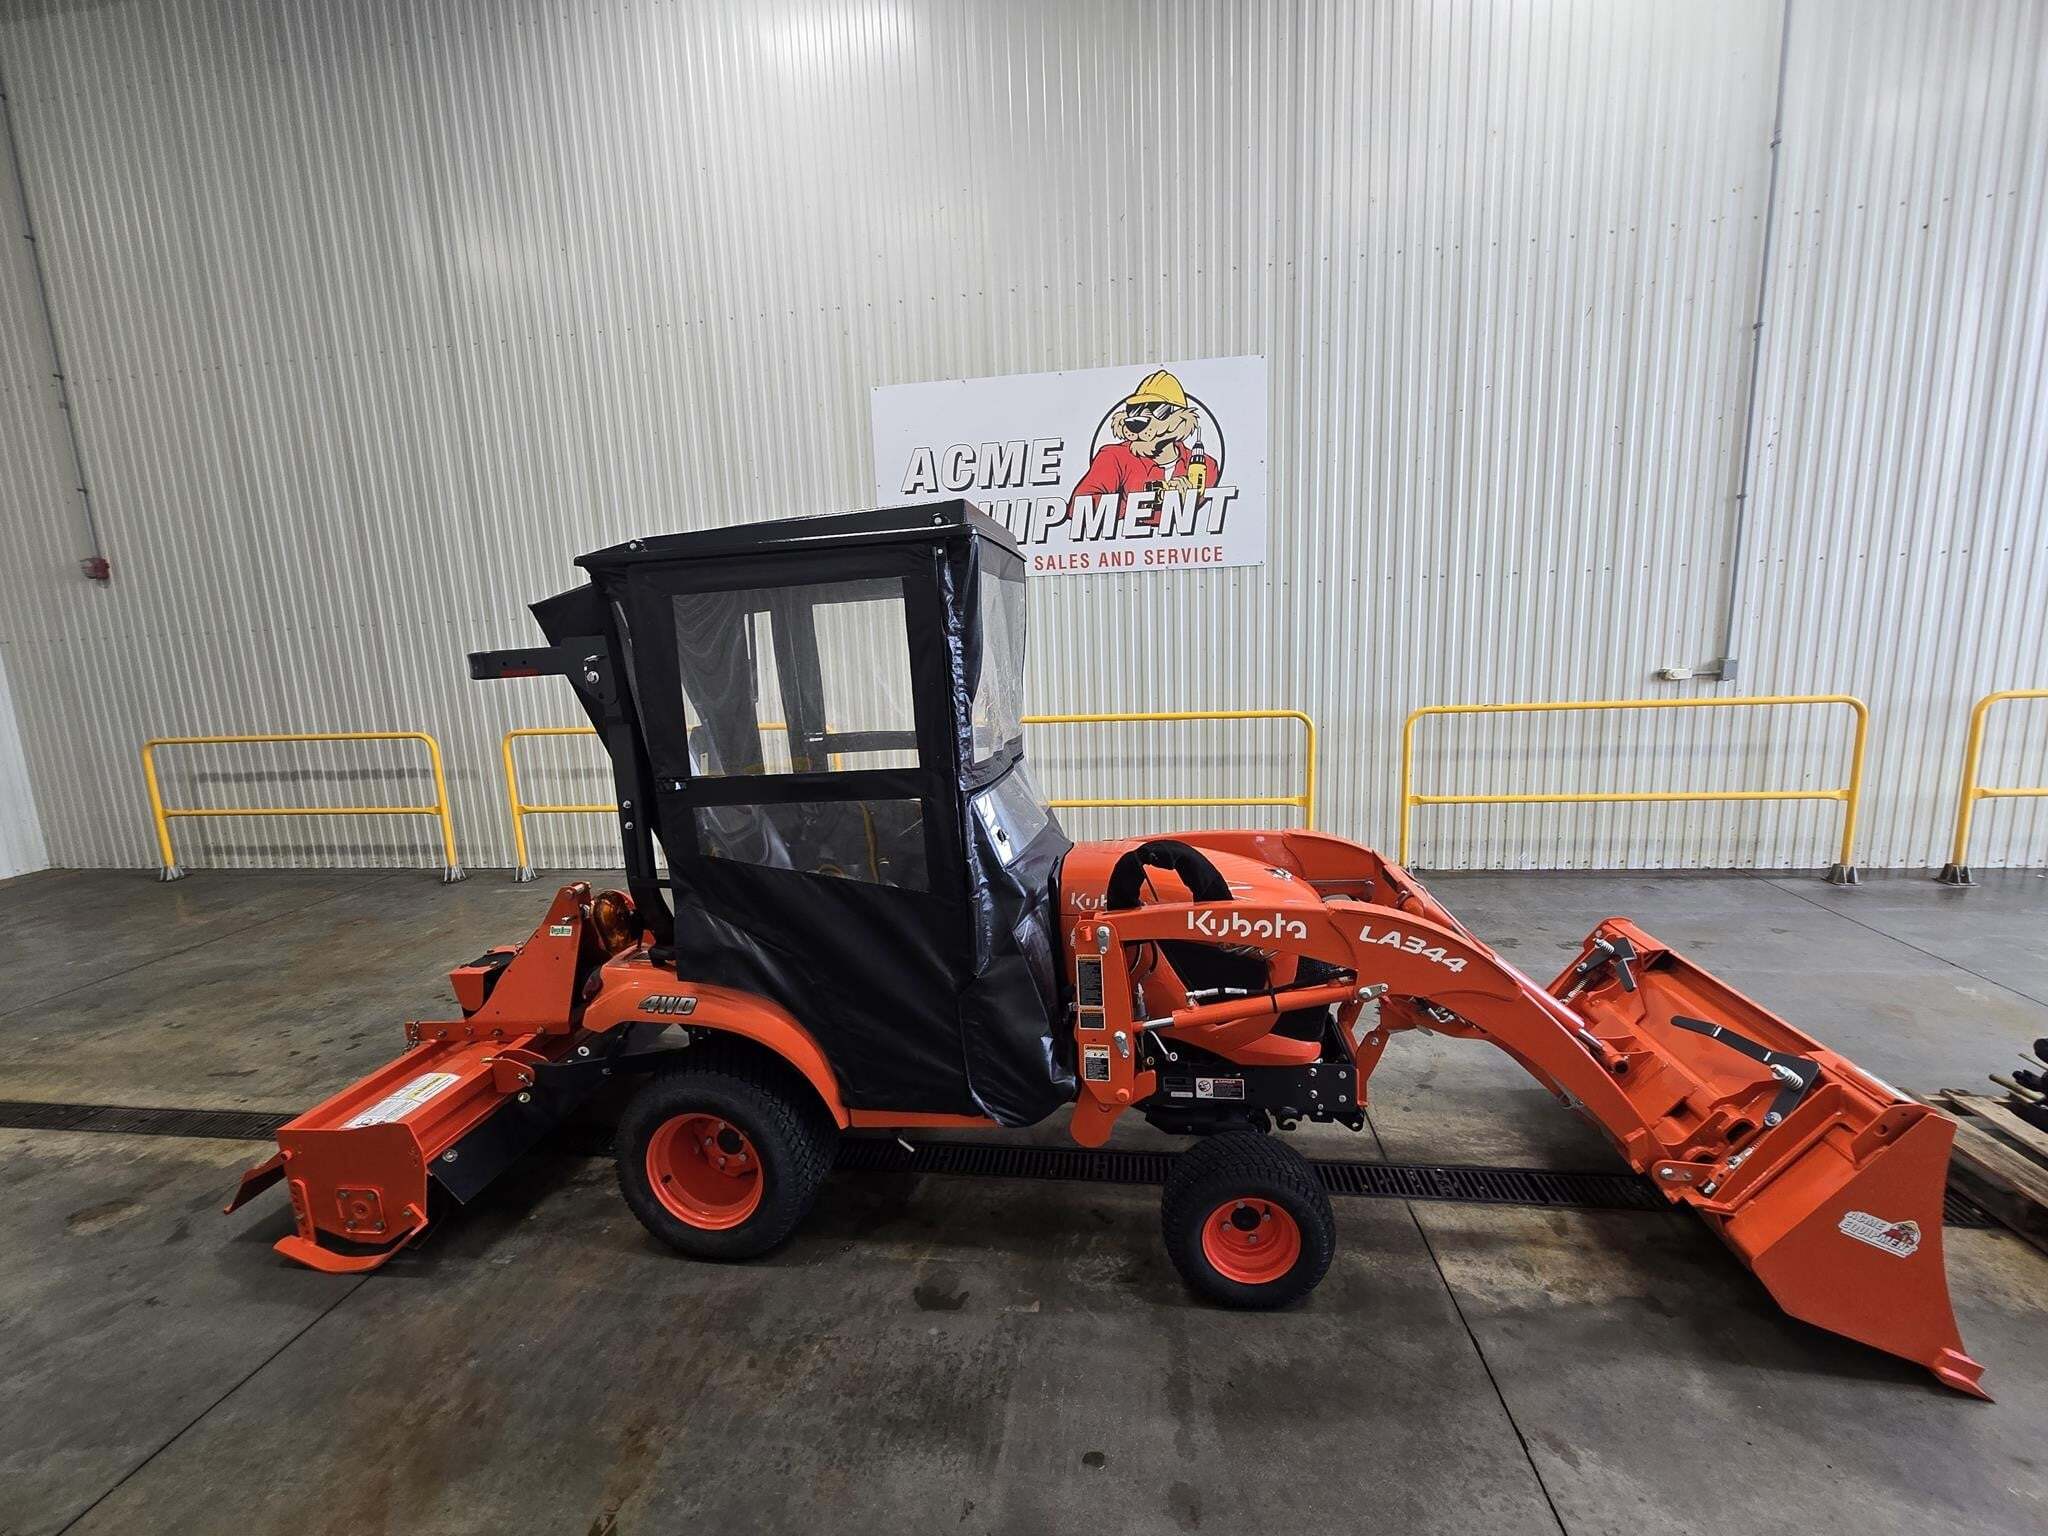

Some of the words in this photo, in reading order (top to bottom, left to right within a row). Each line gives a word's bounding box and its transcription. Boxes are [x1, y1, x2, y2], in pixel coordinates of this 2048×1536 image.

[902, 437, 1064, 494] ACME
[977, 486, 1240, 545] UIPMENT
[1034, 552, 1090, 571] SALES
[1099, 550, 1135, 567] AND
[1144, 546, 1224, 566] SERVICE
[1187, 909, 1308, 940] Kubota
[1358, 925, 1469, 974] LA344
[638, 994, 699, 1016] 4WD
[1840, 1220, 1917, 1254] EQUIPMENT
[1846, 1211, 1887, 1231] ACME
